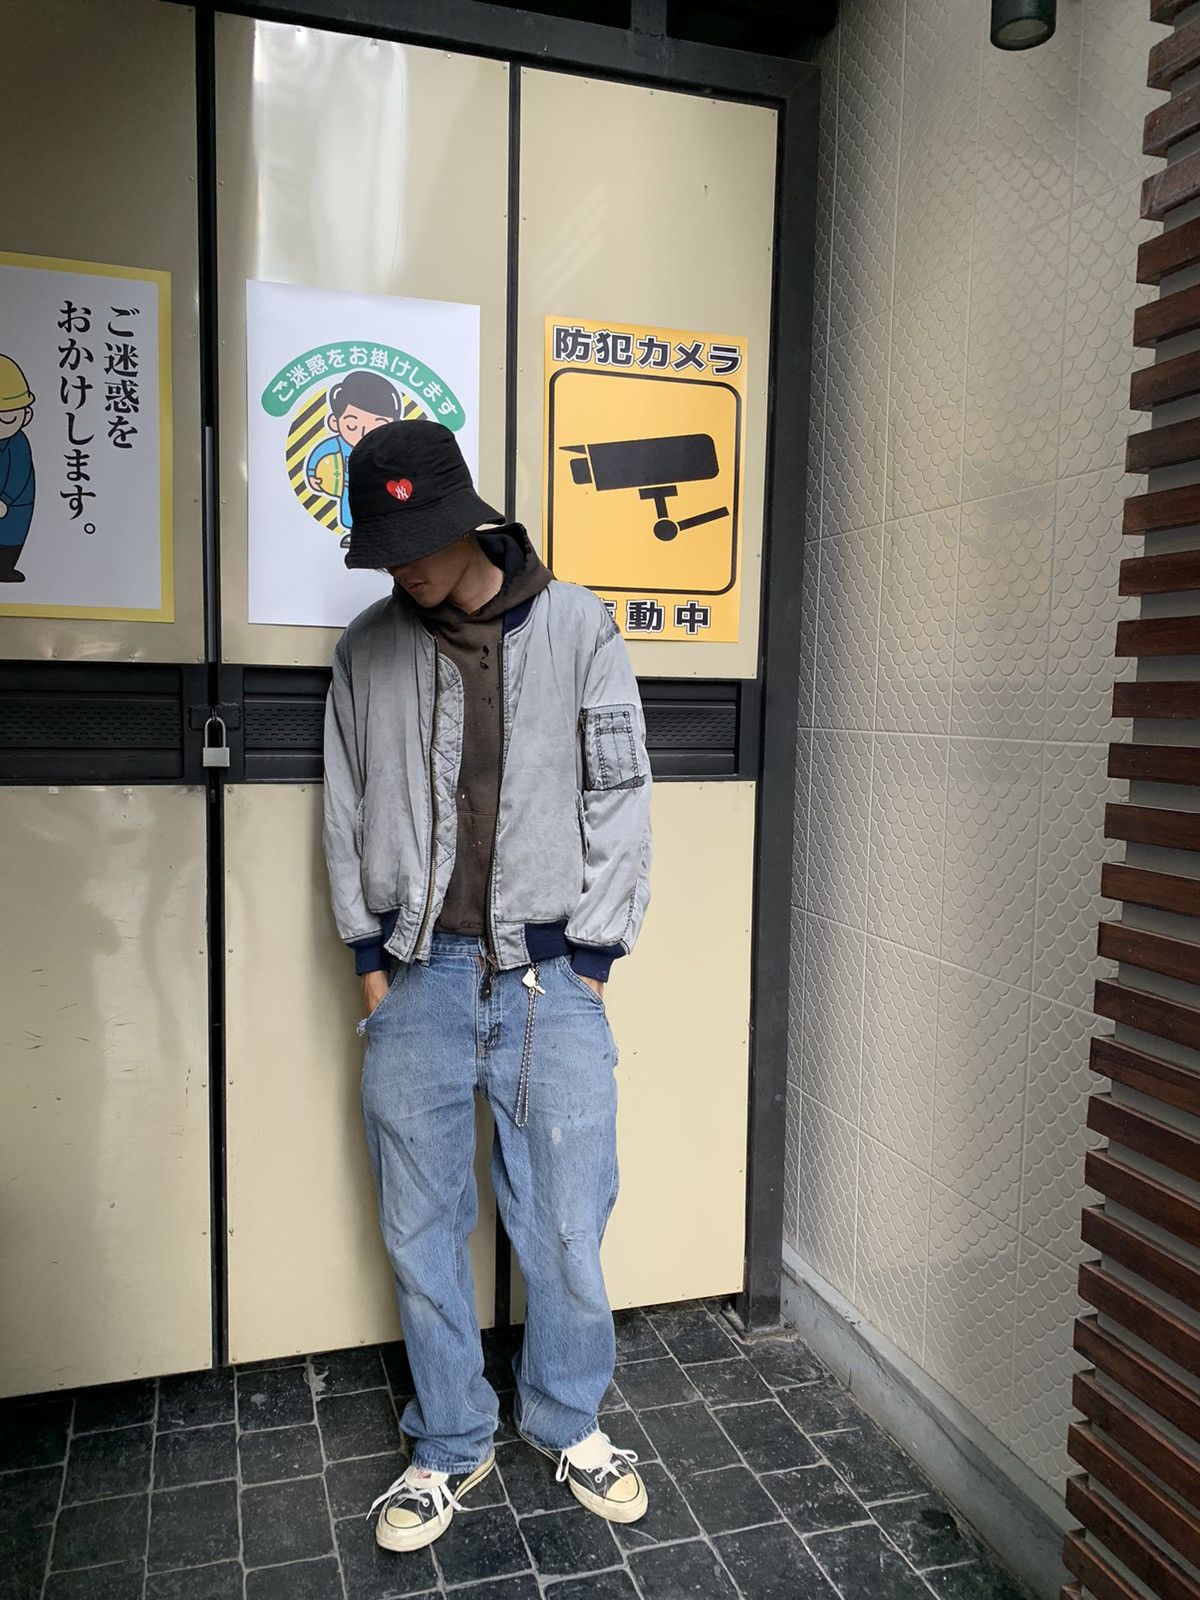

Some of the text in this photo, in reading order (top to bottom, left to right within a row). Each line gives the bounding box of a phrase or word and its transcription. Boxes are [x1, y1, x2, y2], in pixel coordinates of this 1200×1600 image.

[104, 306, 140, 449] ご迷惑を
[272, 346, 458, 416] ご迷惑をお掛けします
[553, 325, 742, 375] 防犯カメラ
[58, 300, 96, 535] おかけします。
[602, 599, 711, 635] 動中
